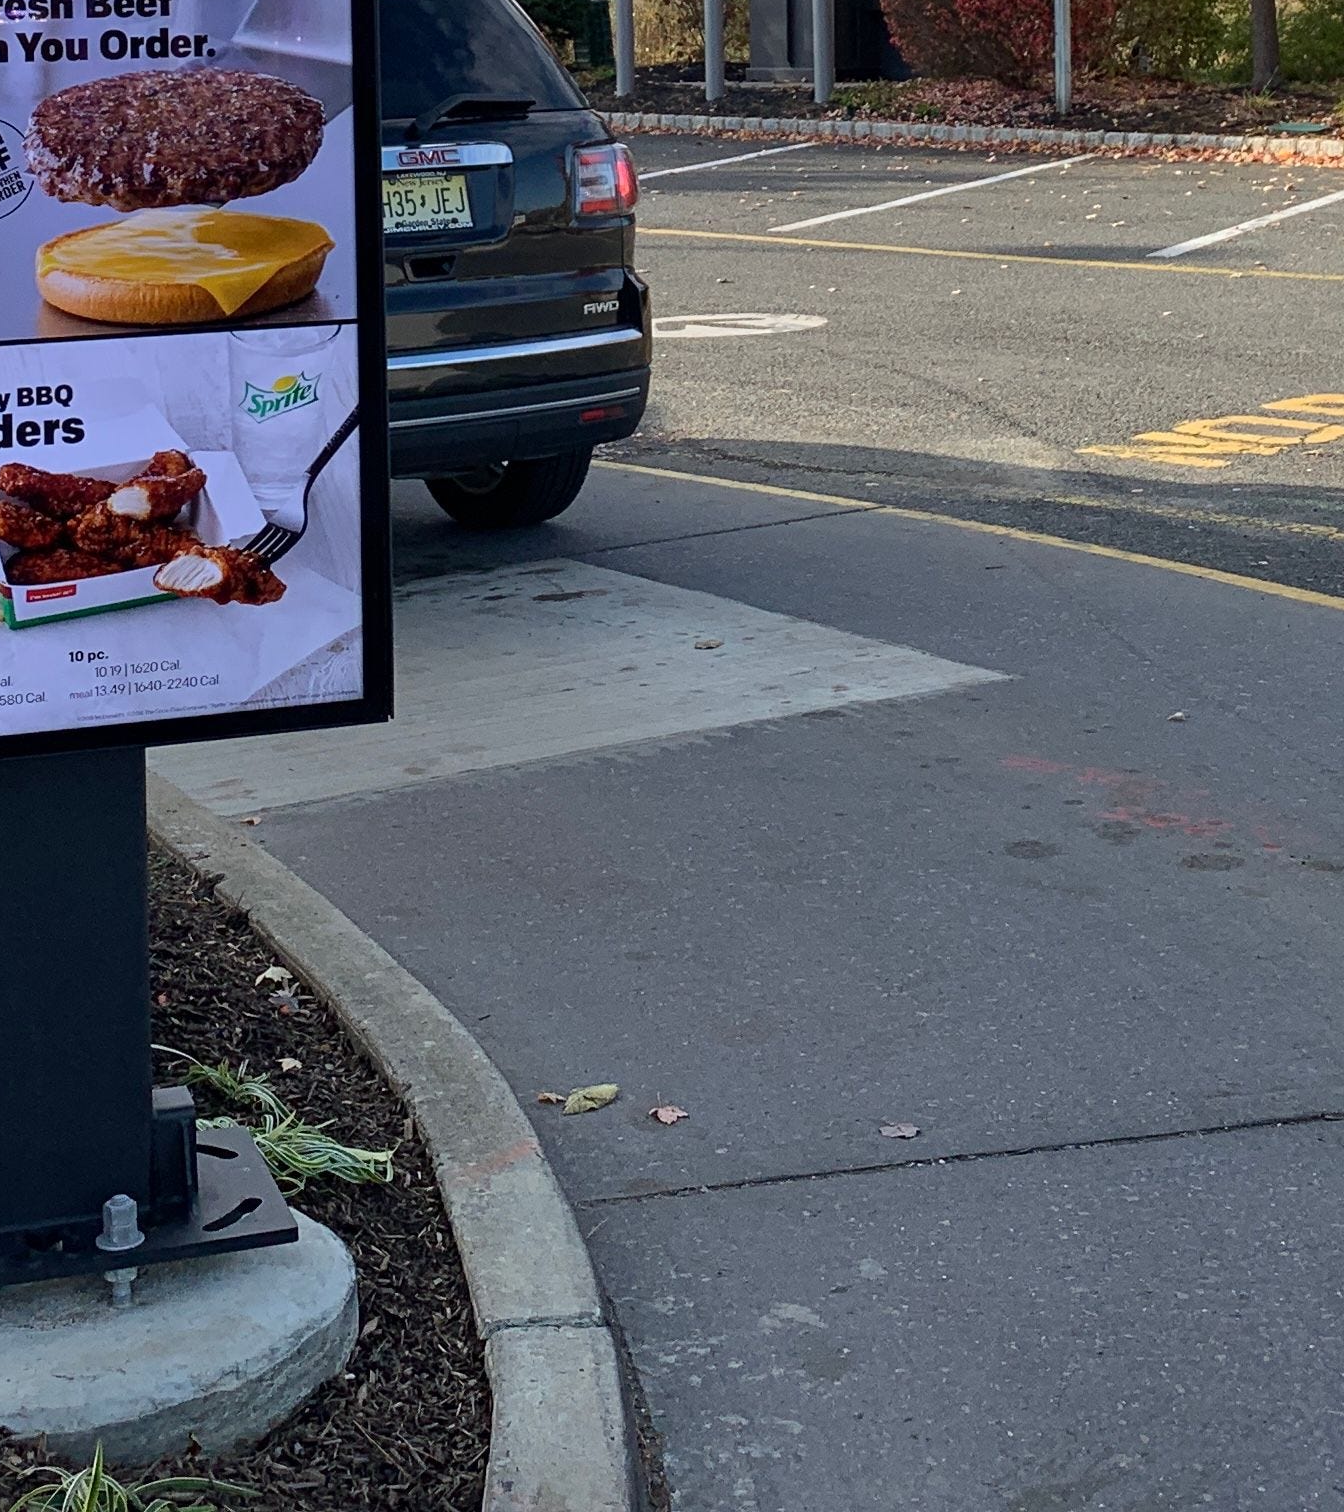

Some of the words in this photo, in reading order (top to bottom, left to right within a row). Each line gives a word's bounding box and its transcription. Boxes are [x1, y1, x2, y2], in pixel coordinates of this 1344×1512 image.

[16, 32, 88, 62] You
[99, 28, 216, 60] Order.
[397, 149, 461, 167] GMC
[431, 186, 466, 215] JEJ
[584, 300, 620, 315] AWD
[17, 384, 73, 407] BBQ
[247, 382, 312, 417] Sprite
[68, 650, 84, 663] 10
[87, 650, 109, 664] pc.
[130, 661, 158, 674] 1620
[69, 689, 93, 700] meal
[94, 683, 126, 697] 13.49
[134, 676, 198, 694] 1640-2240
